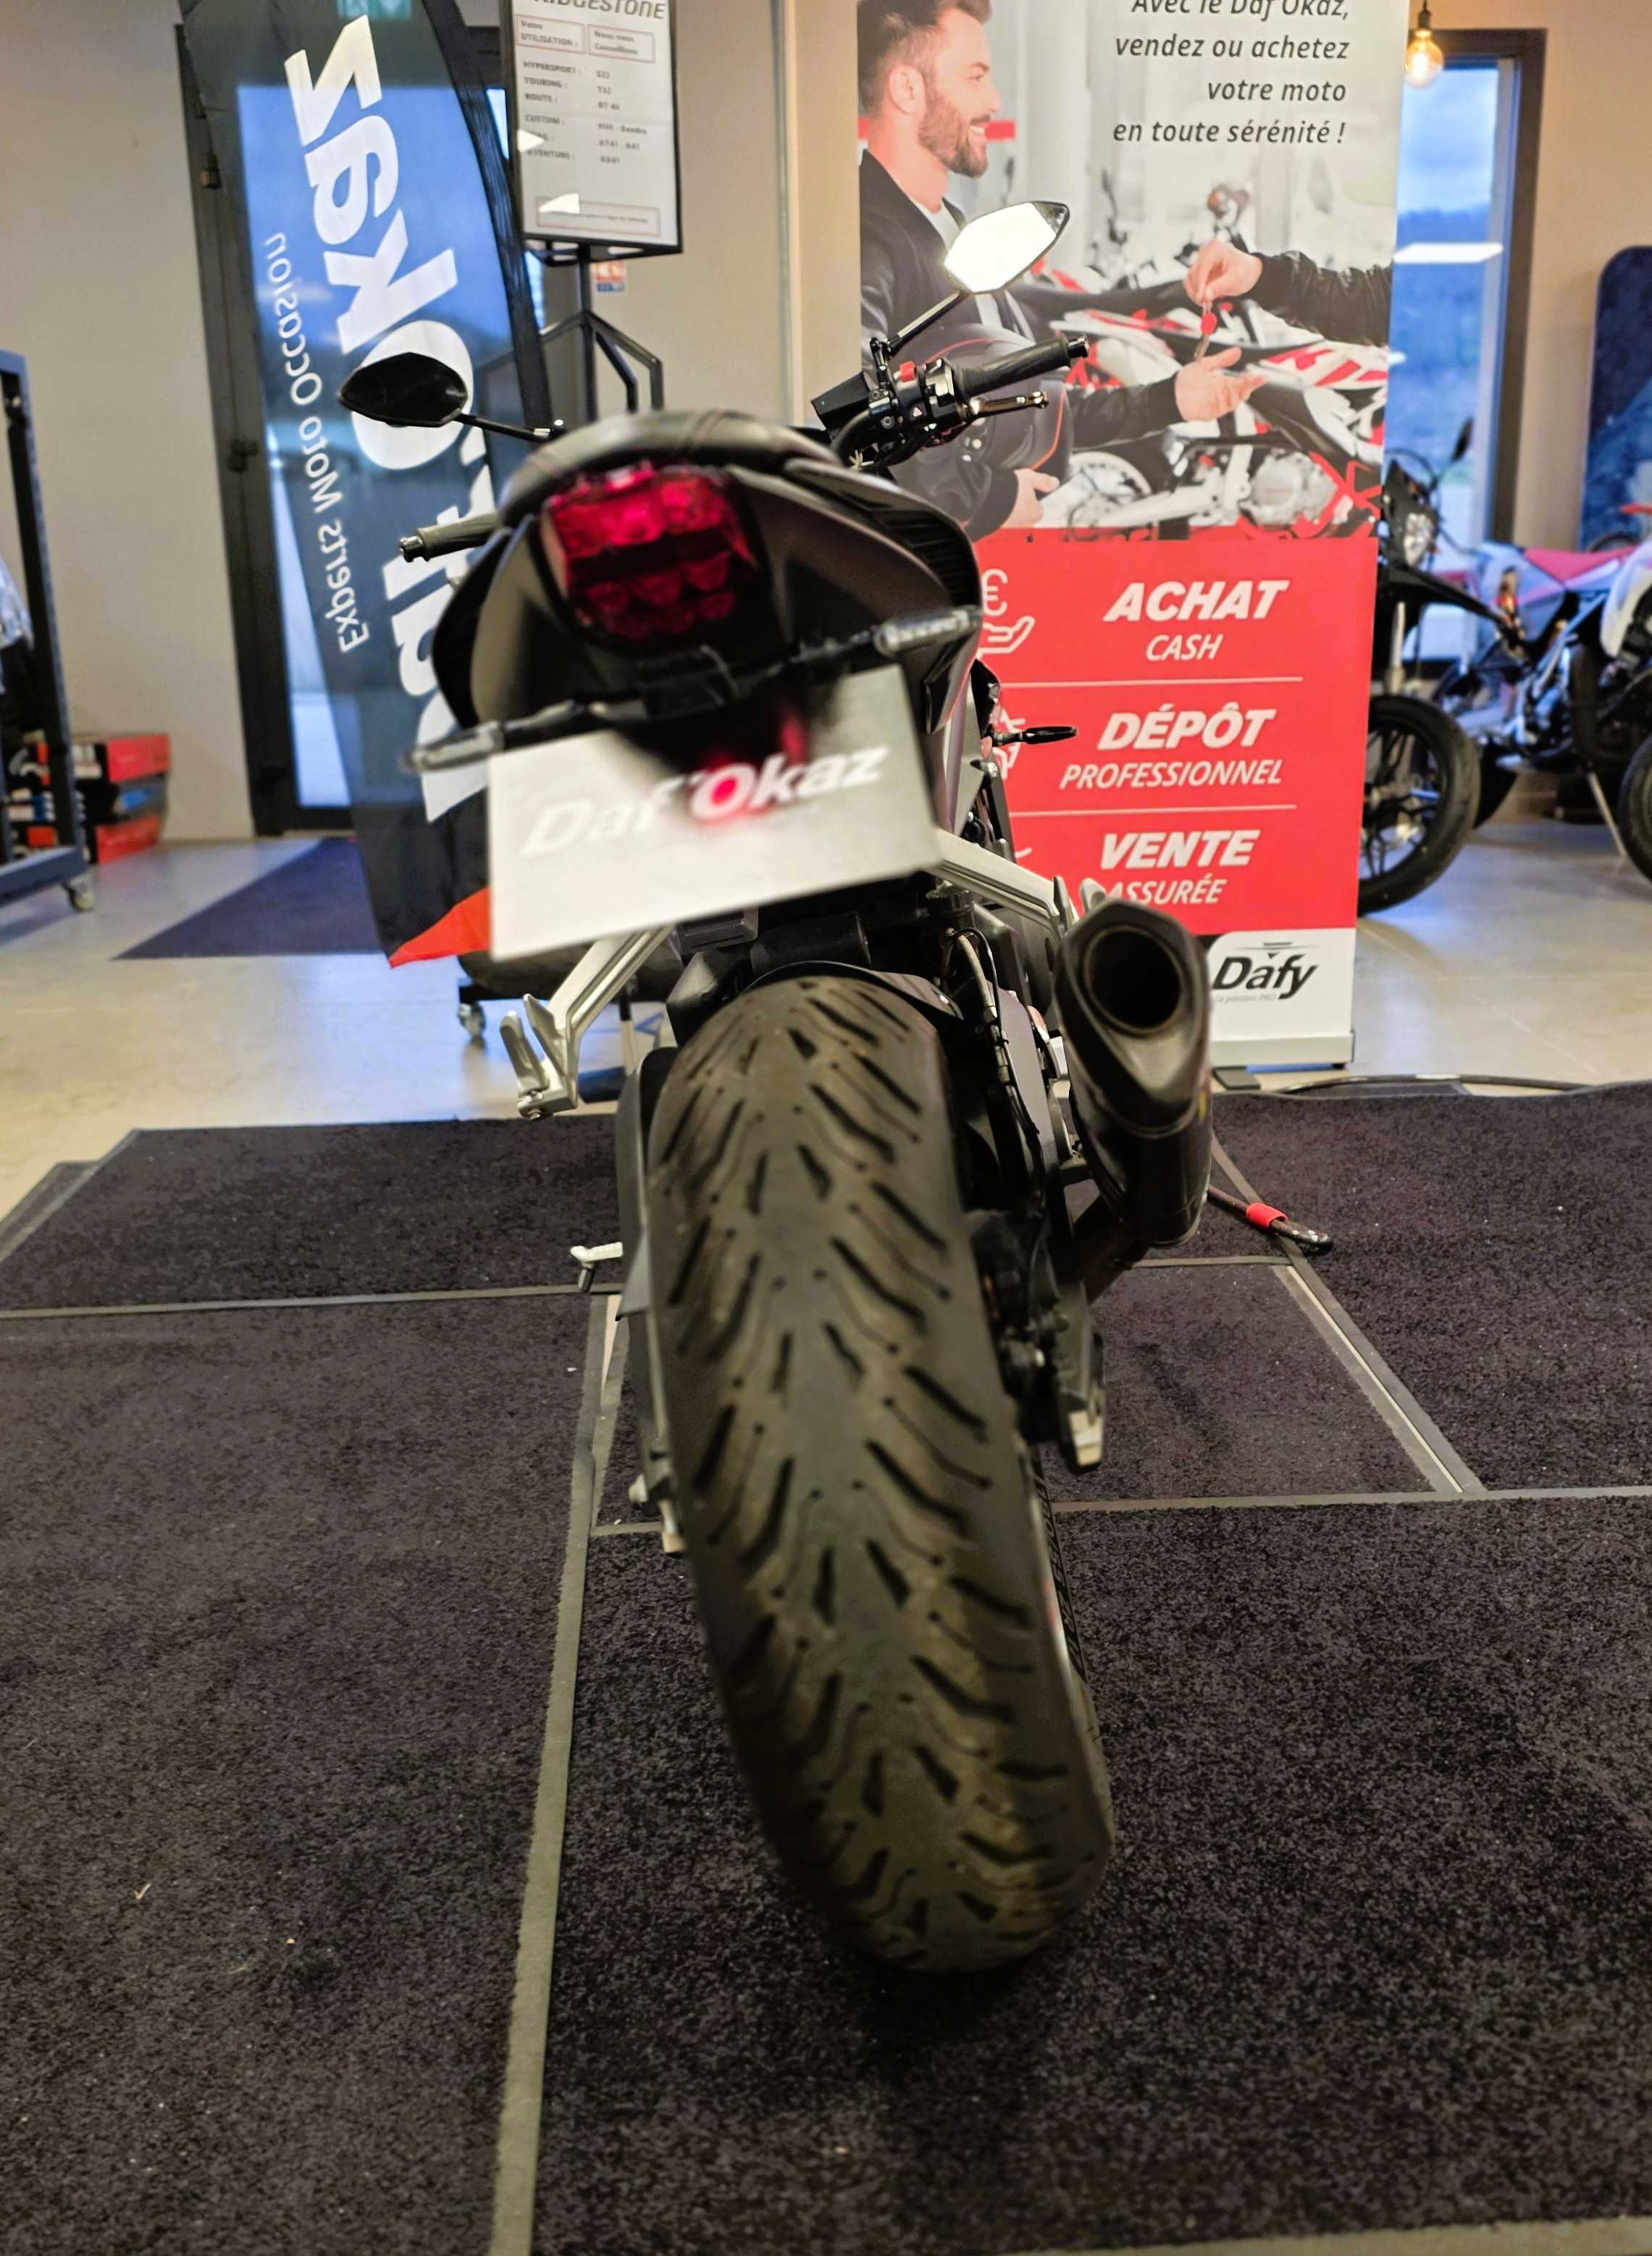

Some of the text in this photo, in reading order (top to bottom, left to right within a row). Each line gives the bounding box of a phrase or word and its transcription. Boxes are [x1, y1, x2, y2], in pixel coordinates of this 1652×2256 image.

[534, 0, 667, 19] GESTONE
[1131, 0, 1191, 13] Avec
[1115, 33, 1350, 59] vendez ou achetez
[1208, 79, 1346, 101] votre moto
[1113, 119, 1346, 143] en toute sérénité !
[1102, 579, 1290, 622] ACHAT
[1145, 634, 1224, 661] CASH
[1097, 702, 1278, 751] DÉPÔT
[1059, 759, 1283, 790] PROFESSIONNEL
[1100, 829, 1261, 871] VENTE
[1105, 872, 1228, 905] ASSURÉE
[1212, 952, 1320, 1000] Dafy
